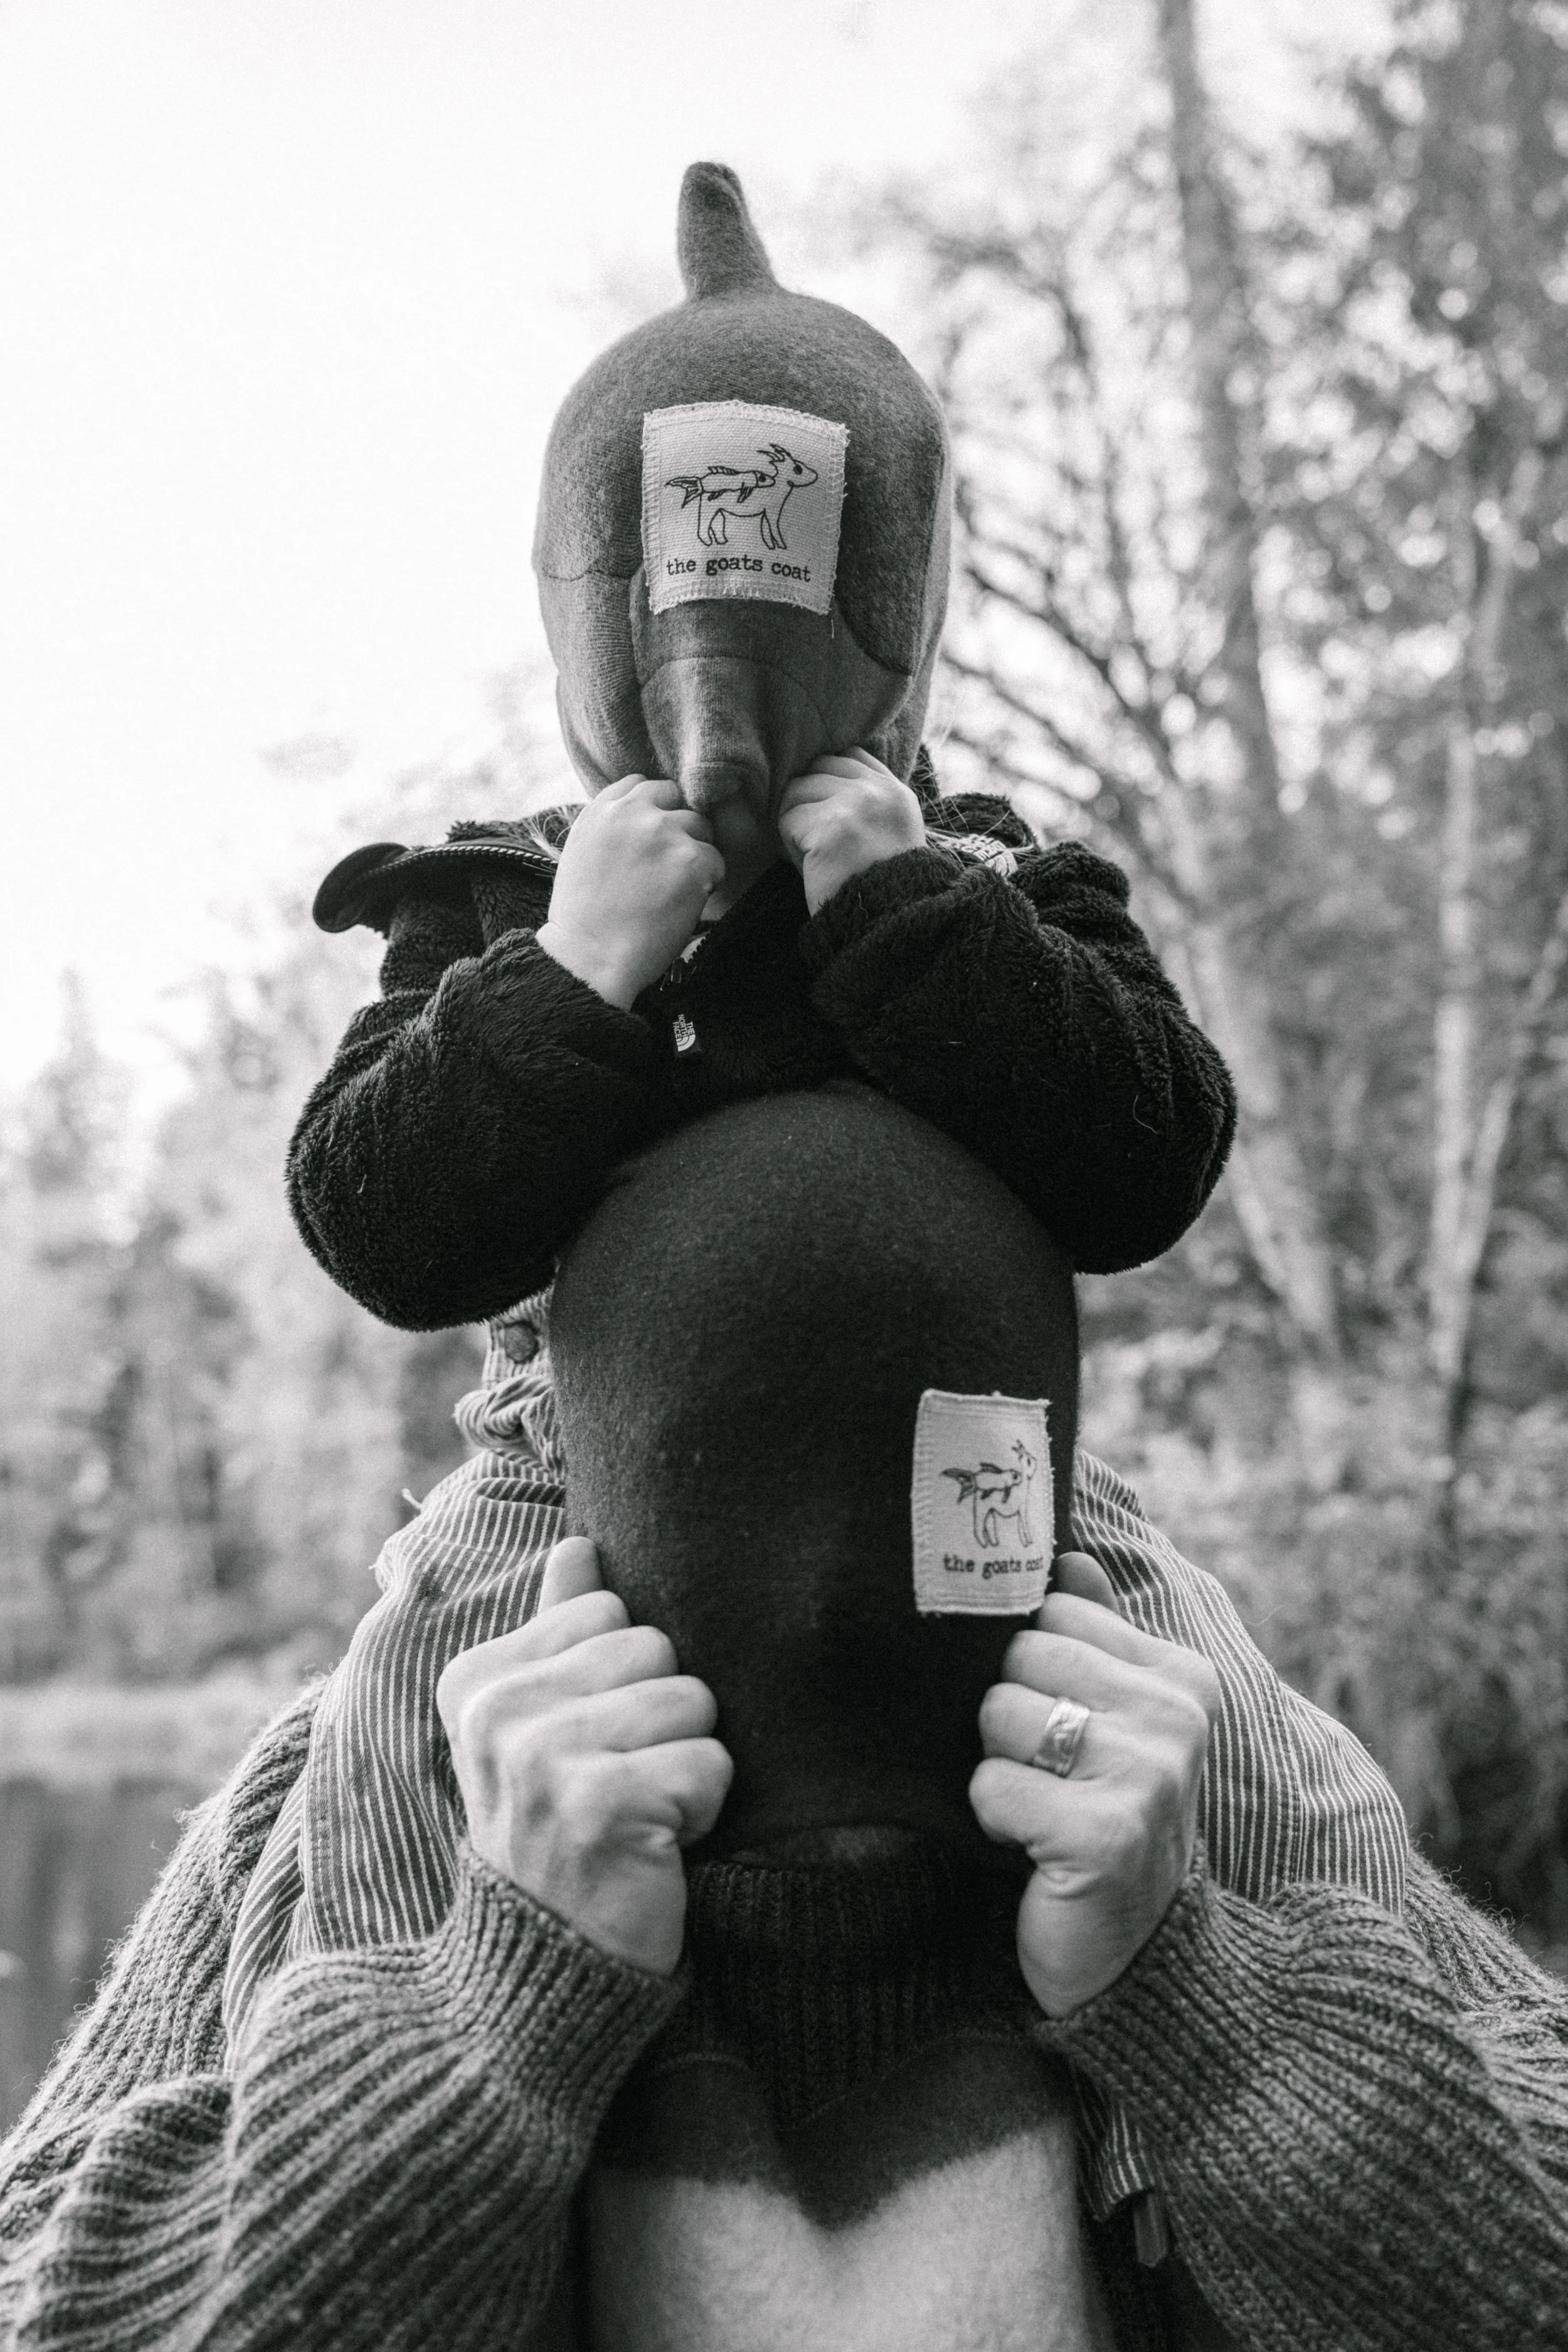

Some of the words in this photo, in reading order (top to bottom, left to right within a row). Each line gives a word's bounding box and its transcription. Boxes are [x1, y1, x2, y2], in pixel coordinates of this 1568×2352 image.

[666, 558, 696, 575] the
[705, 554, 763, 576] goats
[771, 561, 811, 582] coat
[672, 1021, 682, 1039] FACE
[678, 1014, 690, 1037] NORTH
[686, 1021, 695, 1034] THE
[943, 1553, 975, 1573] the
[982, 1557, 1022, 1580] goats
